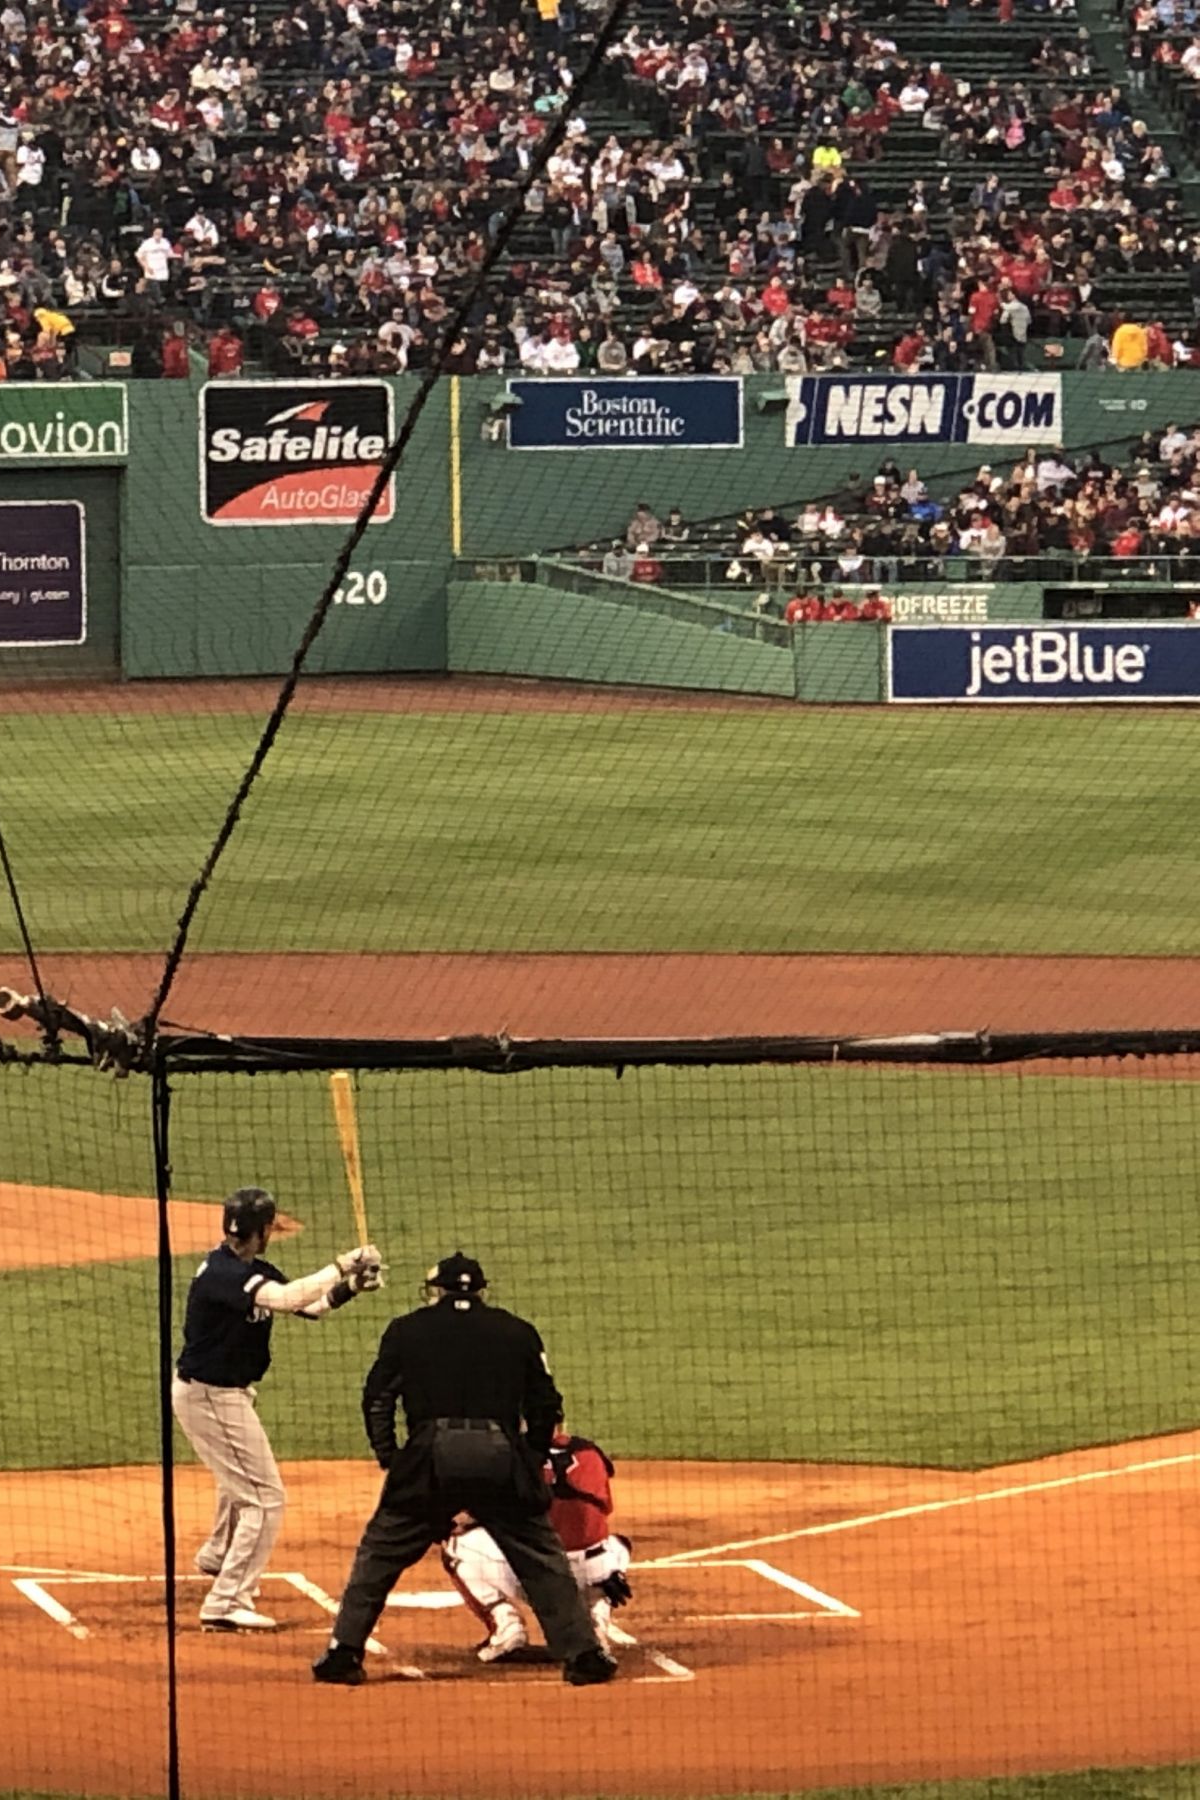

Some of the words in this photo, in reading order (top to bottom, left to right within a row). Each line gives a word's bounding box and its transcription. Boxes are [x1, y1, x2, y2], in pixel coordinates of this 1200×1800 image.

[582, 390, 656, 415] Boston
[824, 385, 946, 435] NESN
[565, 407, 685, 437] Scientific
[208, 426, 386, 462] Safelite
[879, 595, 989, 614] IOFREEZE
[966, 632, 1146, 695] jetBlue
